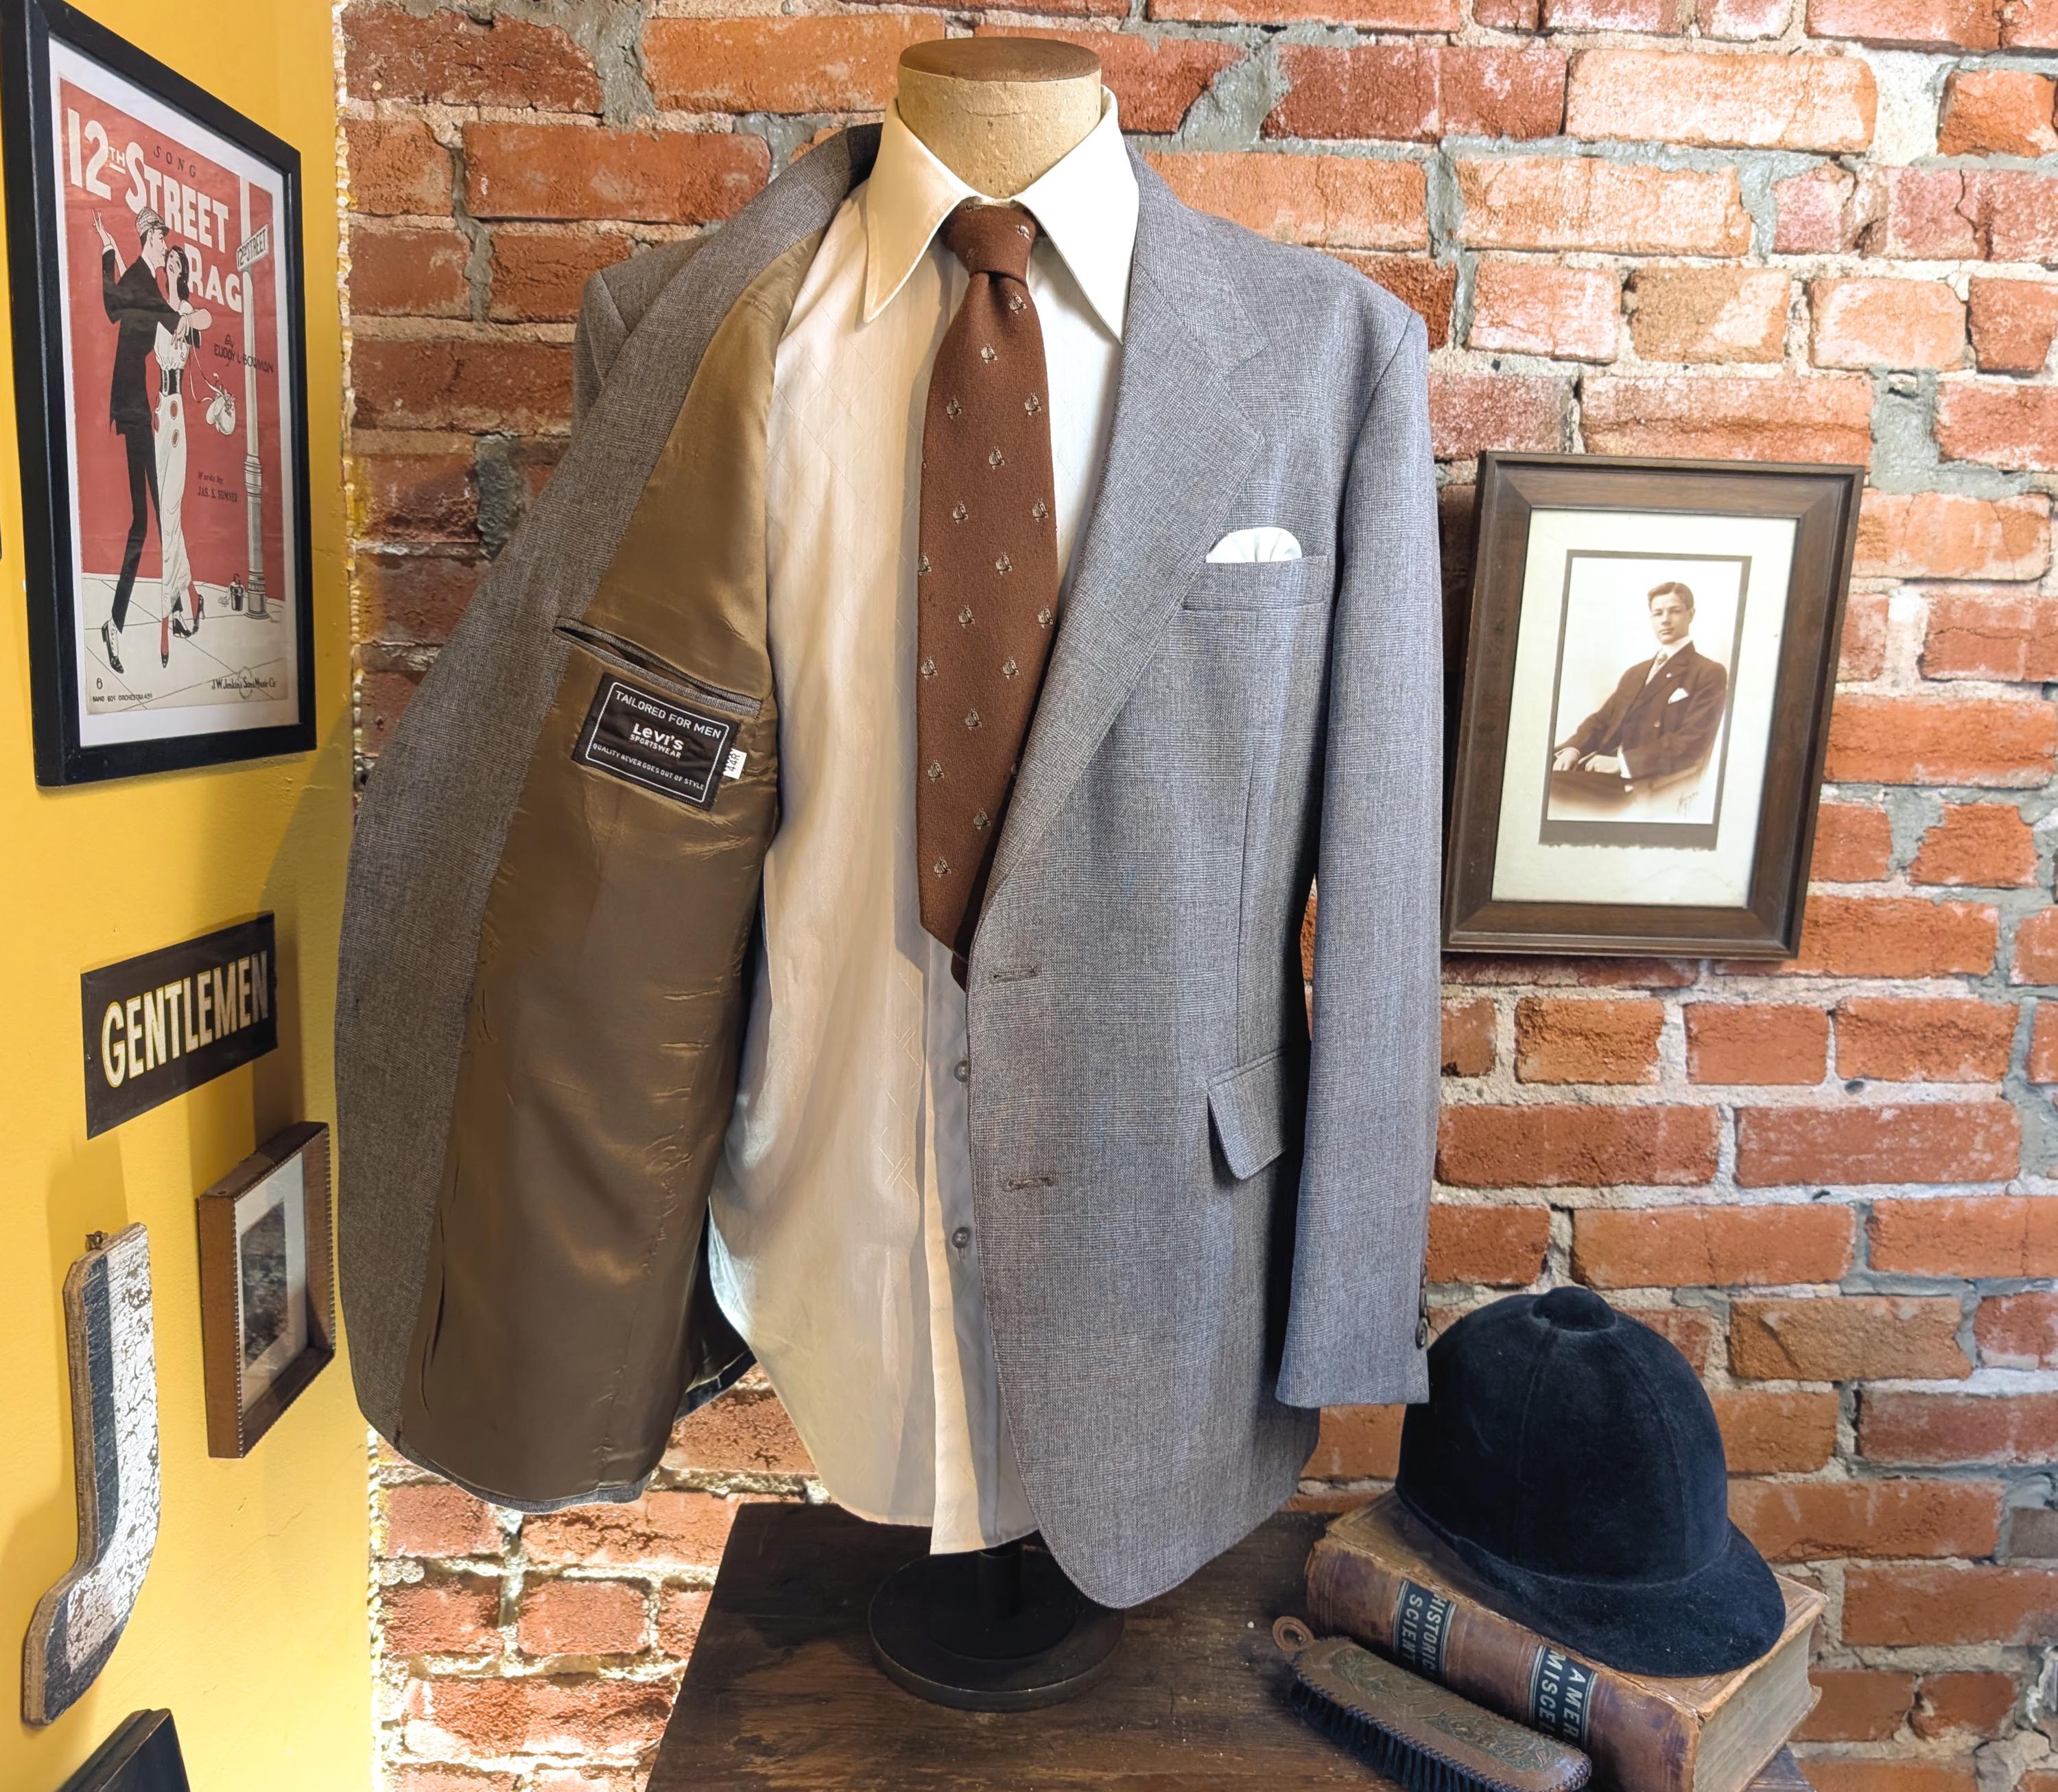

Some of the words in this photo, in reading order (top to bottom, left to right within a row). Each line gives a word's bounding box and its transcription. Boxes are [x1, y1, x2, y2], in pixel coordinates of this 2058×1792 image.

[153, 145, 197, 178] SONG
[125, 141, 229, 254] STREET
[247, 228, 266, 261] STREET
[184, 243, 243, 313] RAG
[198, 471, 215, 482] Words
[216, 475, 224, 486] by
[616, 690, 666, 719] TAILORED
[668, 714, 692, 729] FOR
[694, 722, 722, 739] MEN
[593, 742, 621, 758] QUALITY
[620, 754, 642, 767] NEVER
[642, 762, 660, 774] GOES
[660, 769, 674, 779] OUT
[685, 778, 706, 791] STYLE
[630, 734, 682, 759] SPORTSWEAR
[726, 753, 741, 772] 44R
[102, 950, 269, 1088] GENTLEMEN
